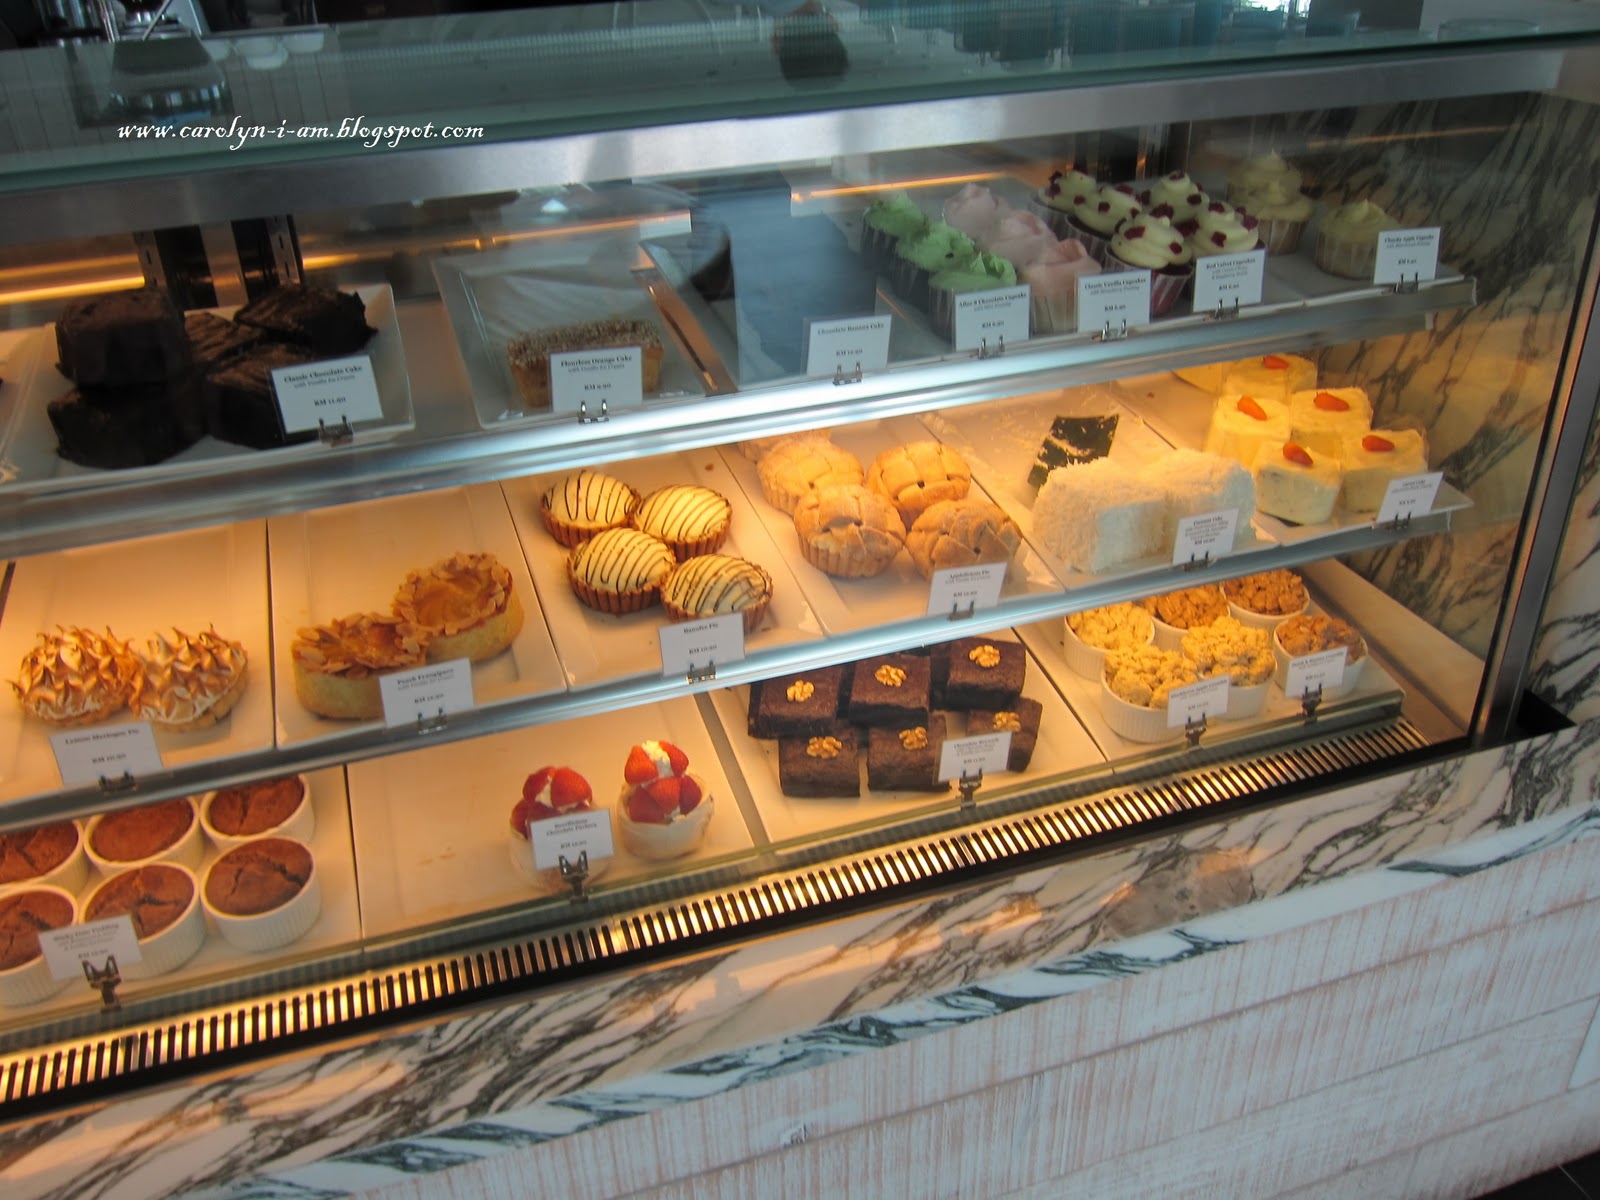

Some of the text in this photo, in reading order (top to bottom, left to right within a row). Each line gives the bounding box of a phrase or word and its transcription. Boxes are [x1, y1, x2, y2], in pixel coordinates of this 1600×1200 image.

[979, 296, 1004, 305] Chocolate
[818, 327, 846, 335] Chocolate
[848, 324, 869, 332] Banana
[561, 355, 633, 368] Flourless Orange Cake
[283, 365, 363, 384] Classic Chocolate Cake
[314, 399, 327, 407] RM
